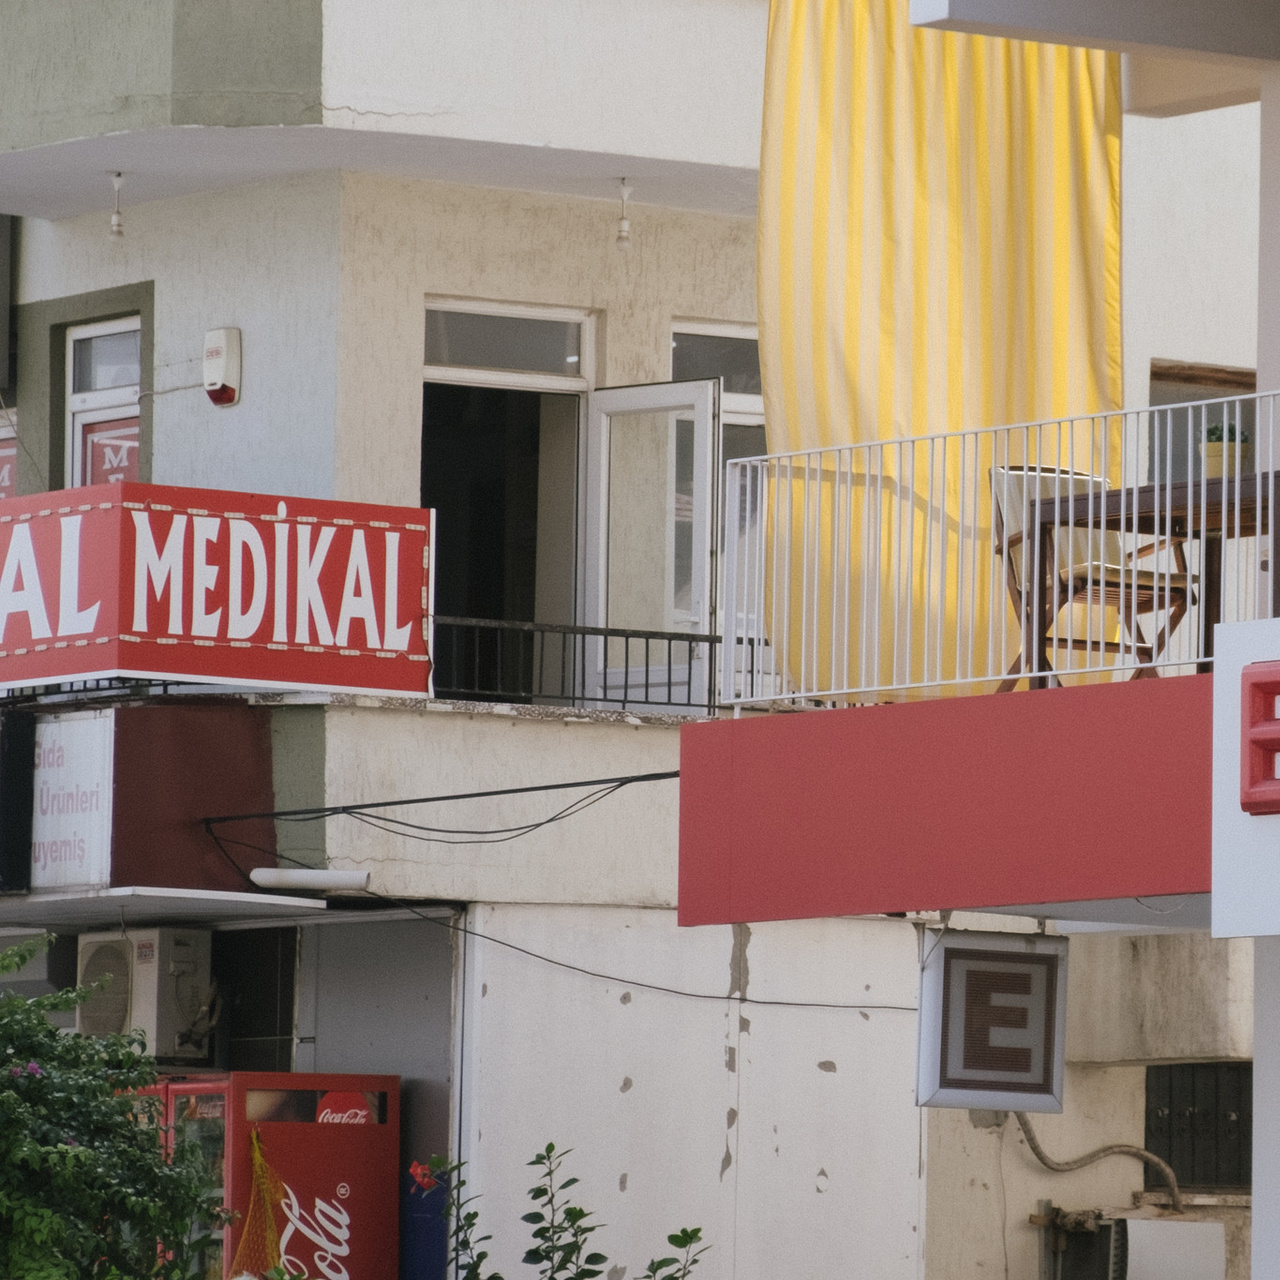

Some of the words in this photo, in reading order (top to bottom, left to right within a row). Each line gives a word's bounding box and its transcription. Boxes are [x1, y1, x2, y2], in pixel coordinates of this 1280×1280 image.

[131, 501, 412, 651] MEDİKAL
[39, 781, 100, 816] Ürünleri
[963, 969, 1032, 1073] E
